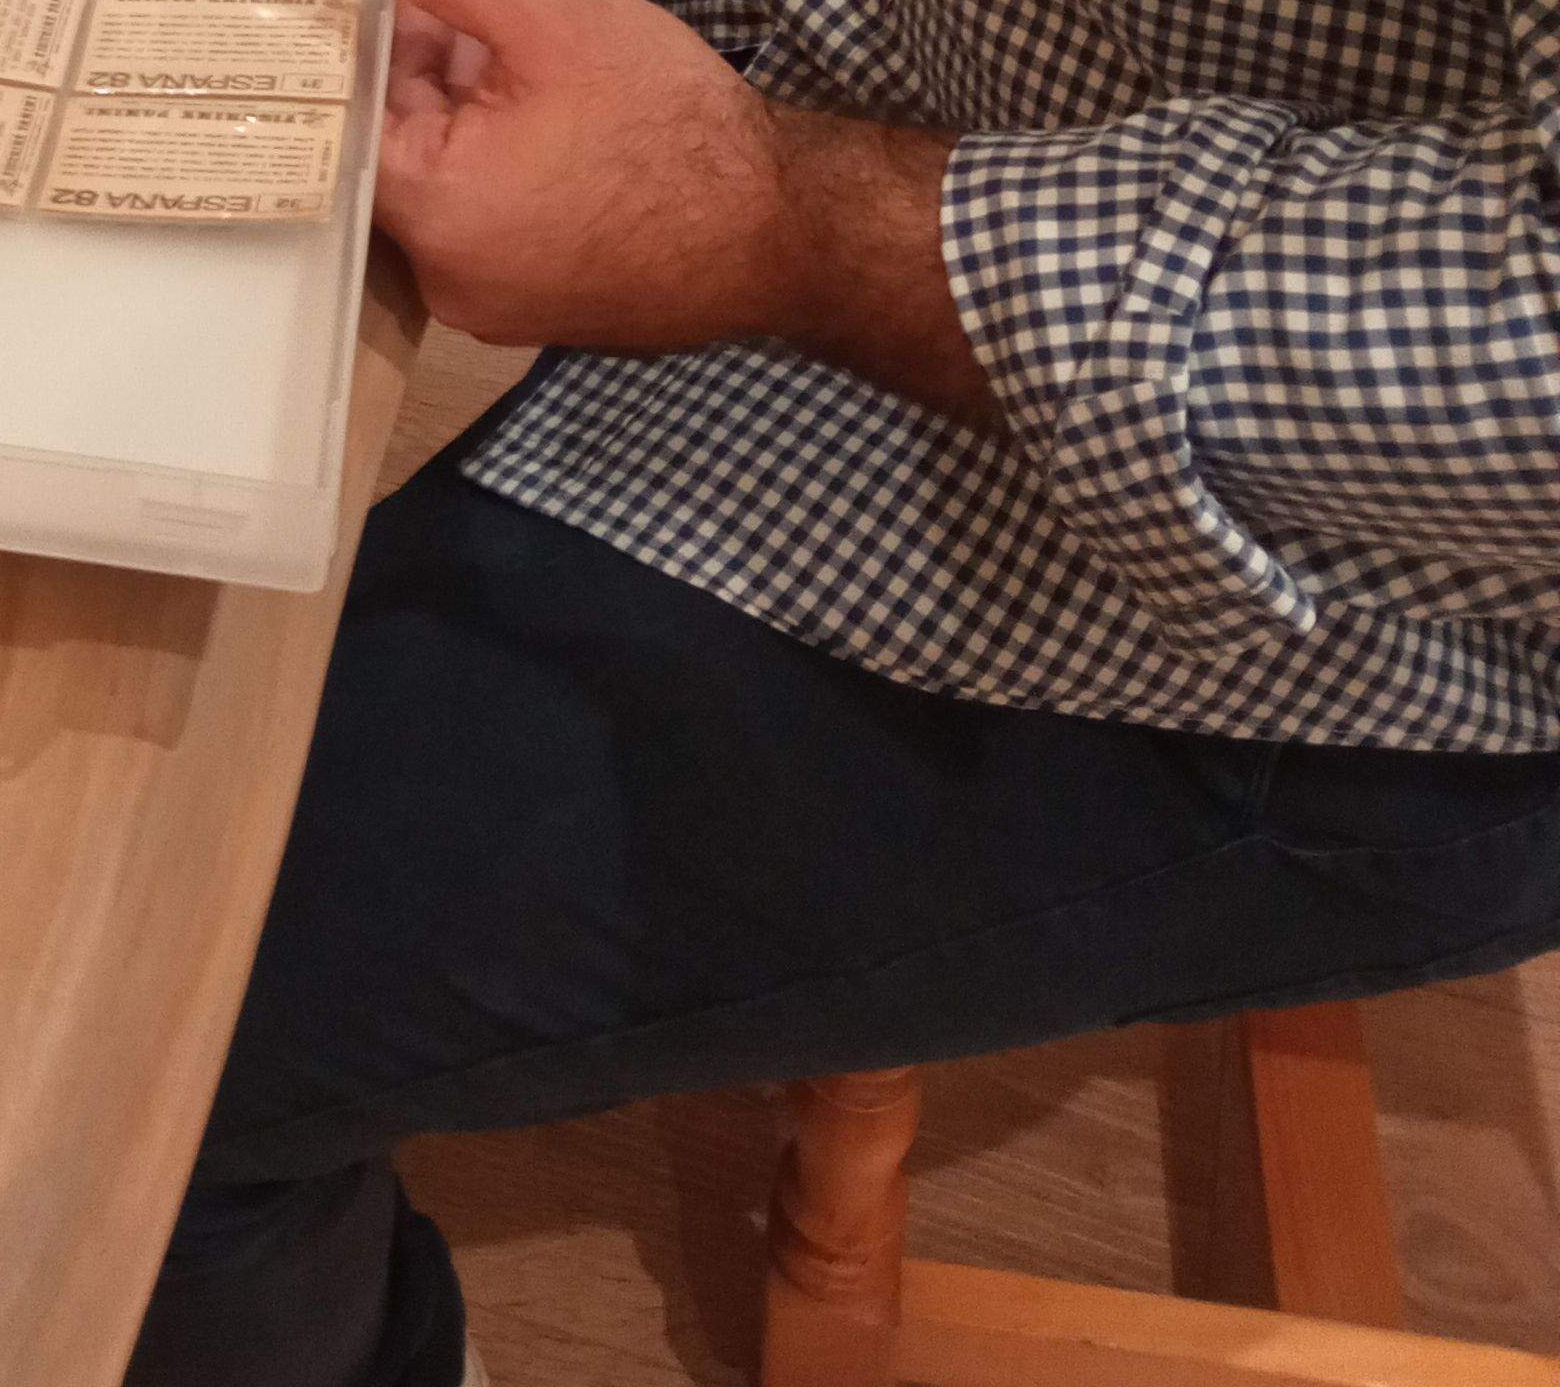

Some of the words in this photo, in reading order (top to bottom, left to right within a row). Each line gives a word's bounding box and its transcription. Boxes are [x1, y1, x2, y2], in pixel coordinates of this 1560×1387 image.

[88, 71, 130, 86] 82
[140, 71, 276, 90] ESPAÑA
[52, 189, 97, 204] 82
[108, 192, 251, 211] ESPAÑA
